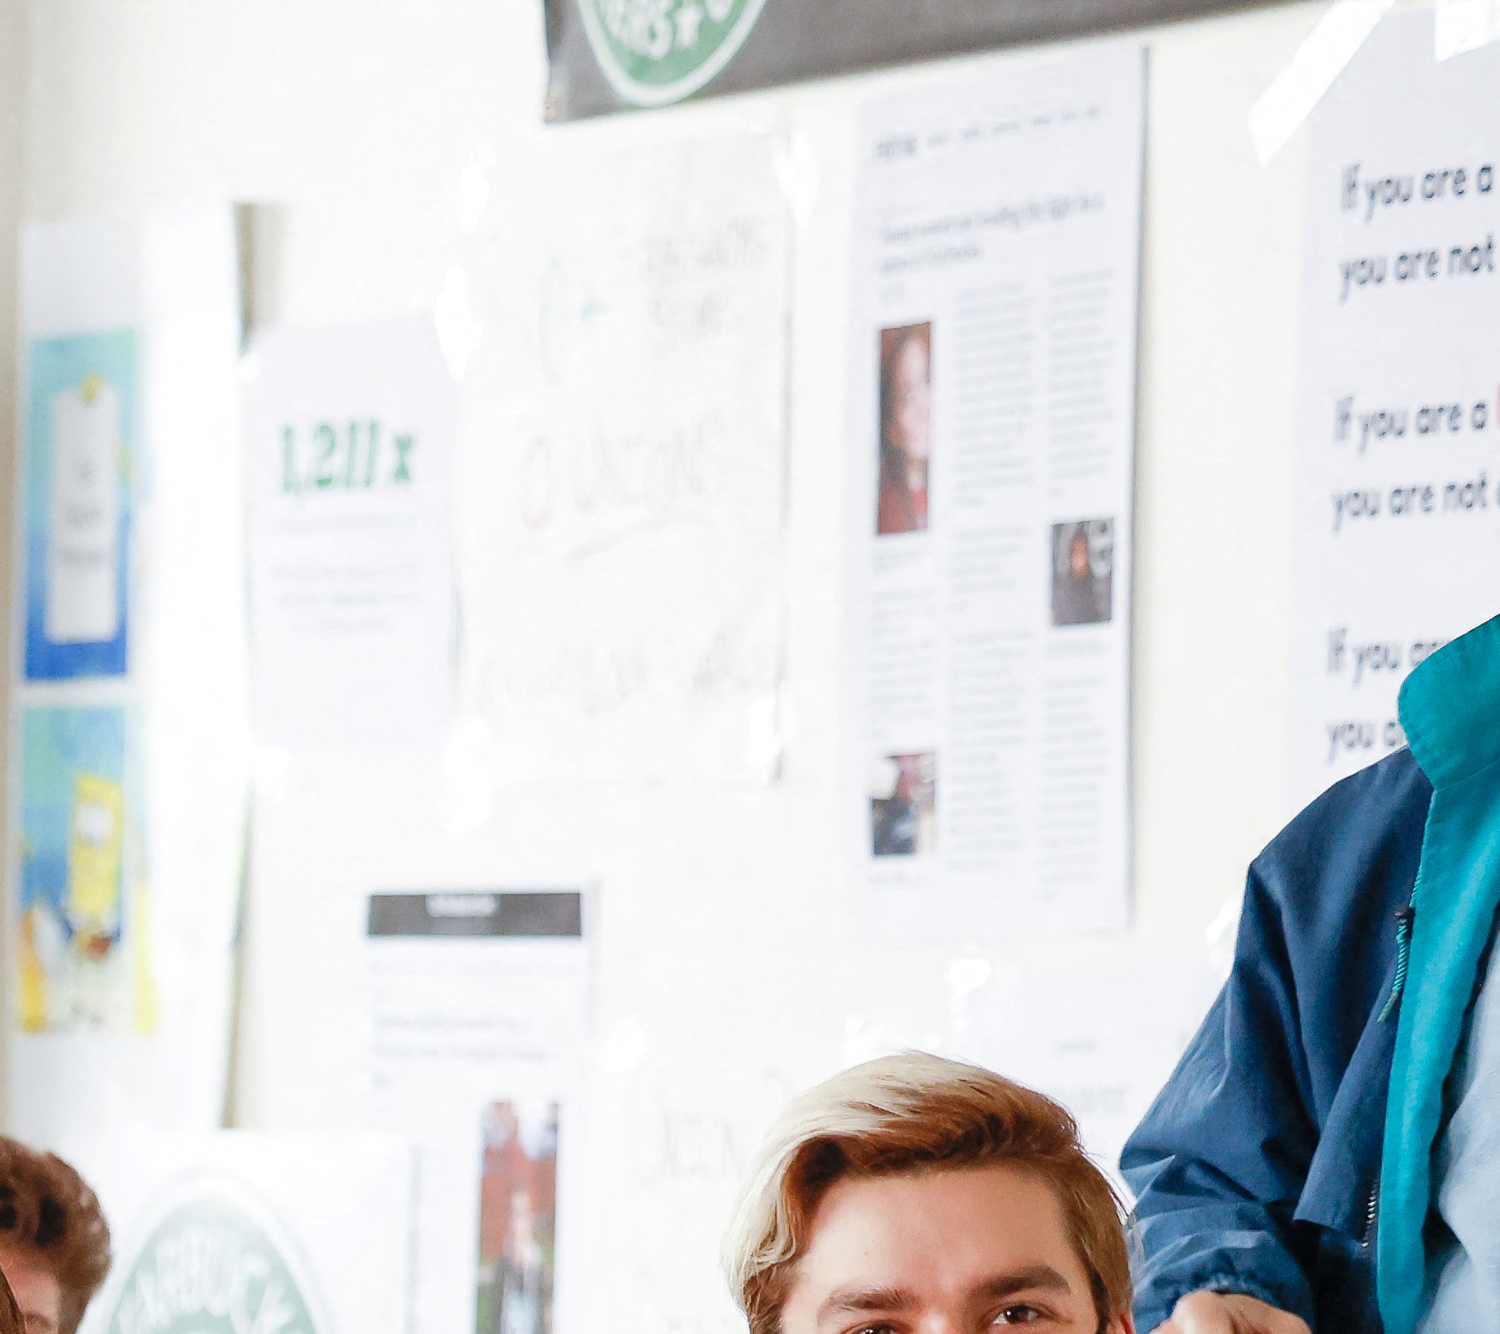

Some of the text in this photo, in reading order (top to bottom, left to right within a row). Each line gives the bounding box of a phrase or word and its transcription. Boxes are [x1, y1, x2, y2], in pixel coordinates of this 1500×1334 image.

[1341, 162, 1495, 224] If you are a
[1339, 234, 1496, 303] you are not
[1334, 394, 1489, 455] If you are a
[1330, 471, 1489, 535] you are not
[1352, 641, 1401, 688] you
[1327, 718, 1376, 767] you
